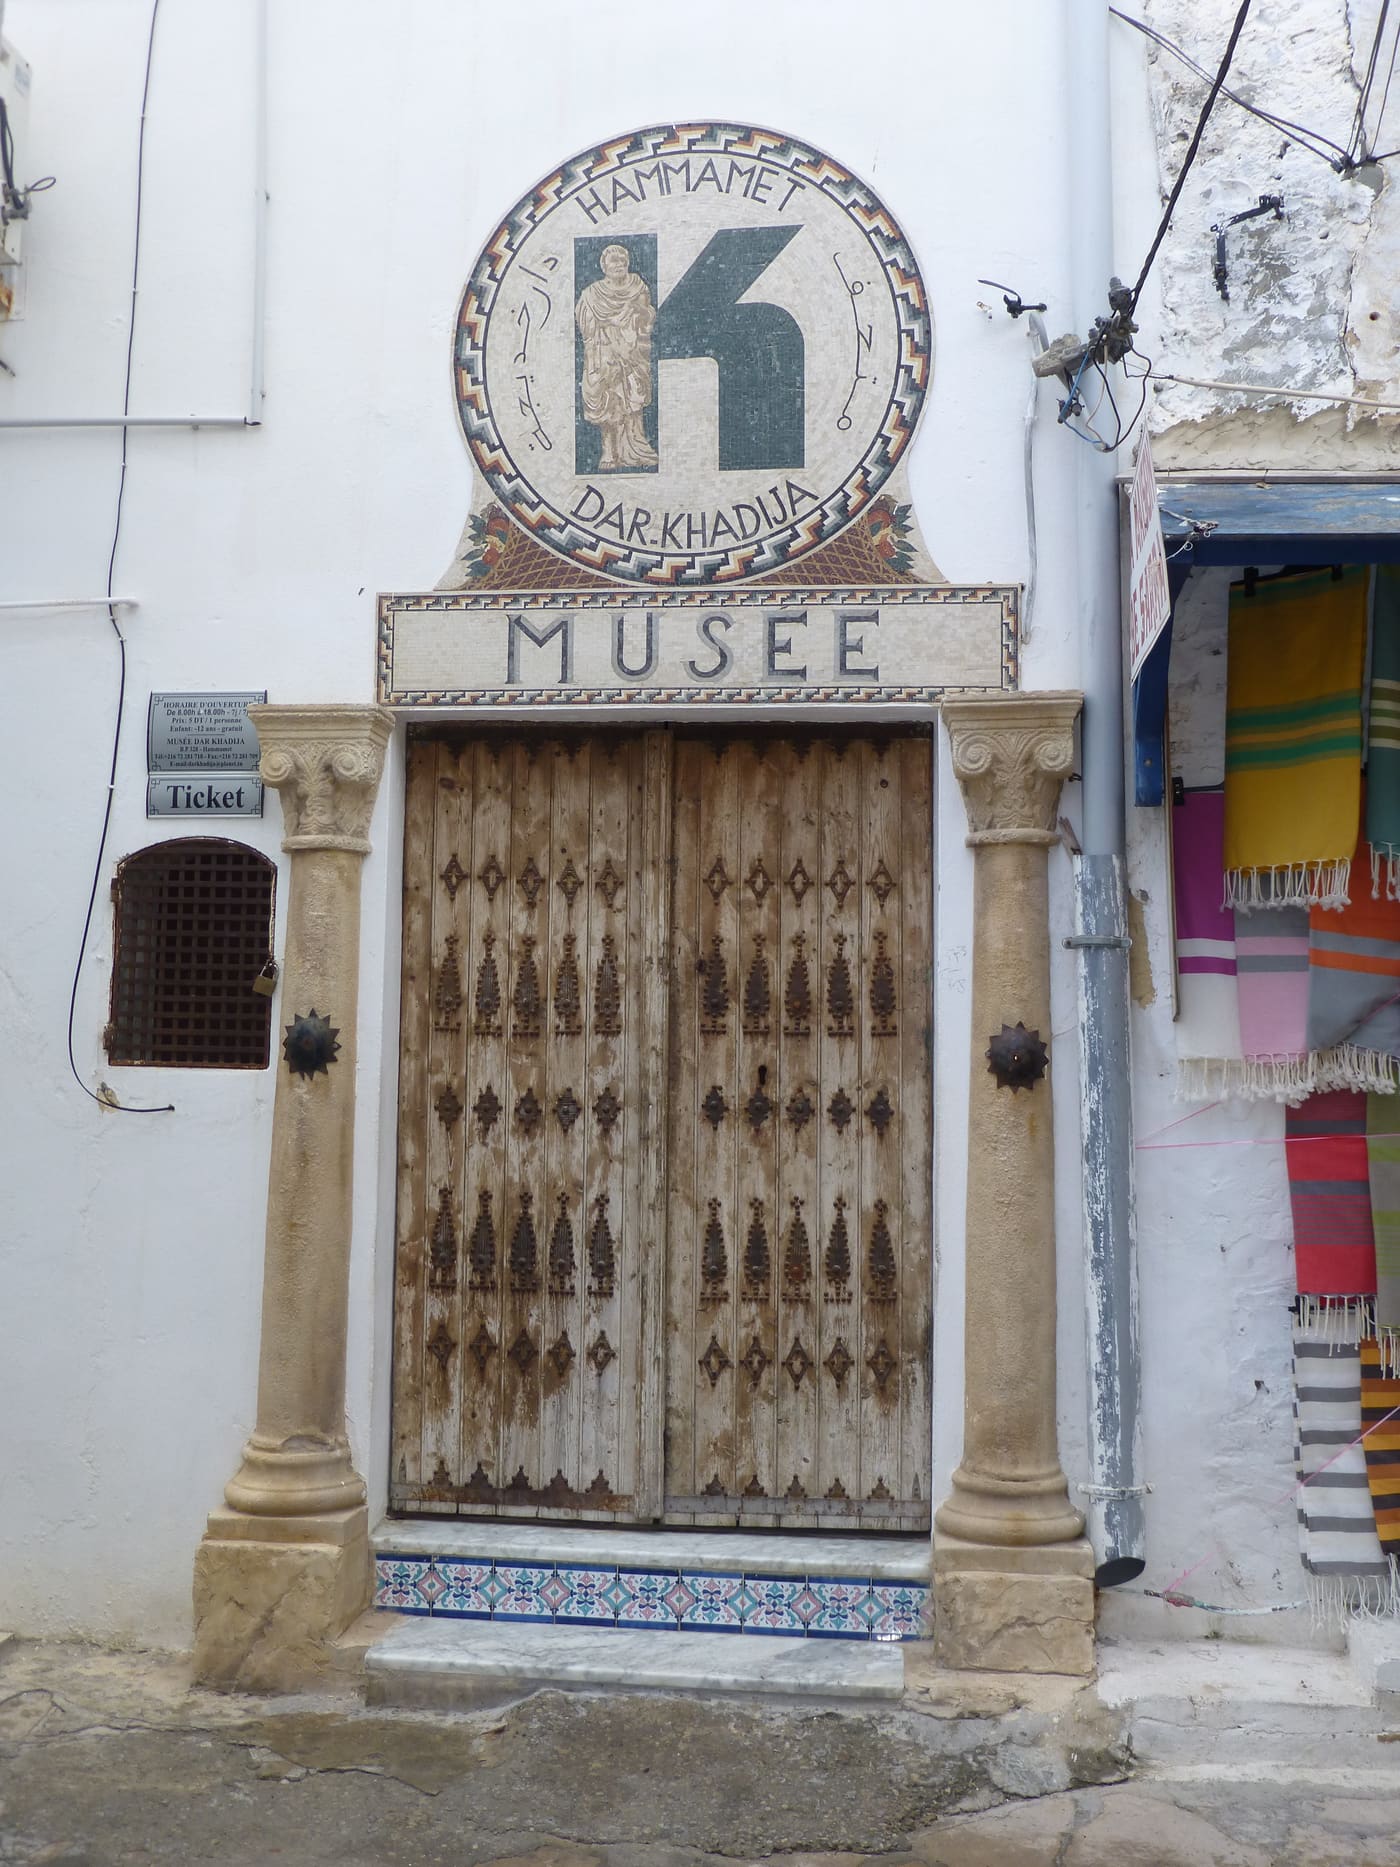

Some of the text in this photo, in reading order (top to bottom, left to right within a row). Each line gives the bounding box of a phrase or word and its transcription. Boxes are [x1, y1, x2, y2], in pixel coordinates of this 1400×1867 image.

[575, 158, 806, 224] HAMMAMET
[518, 256, 558, 330] دار
[833, 251, 877, 430] متحف
[167, 785, 245, 809] Ticket
